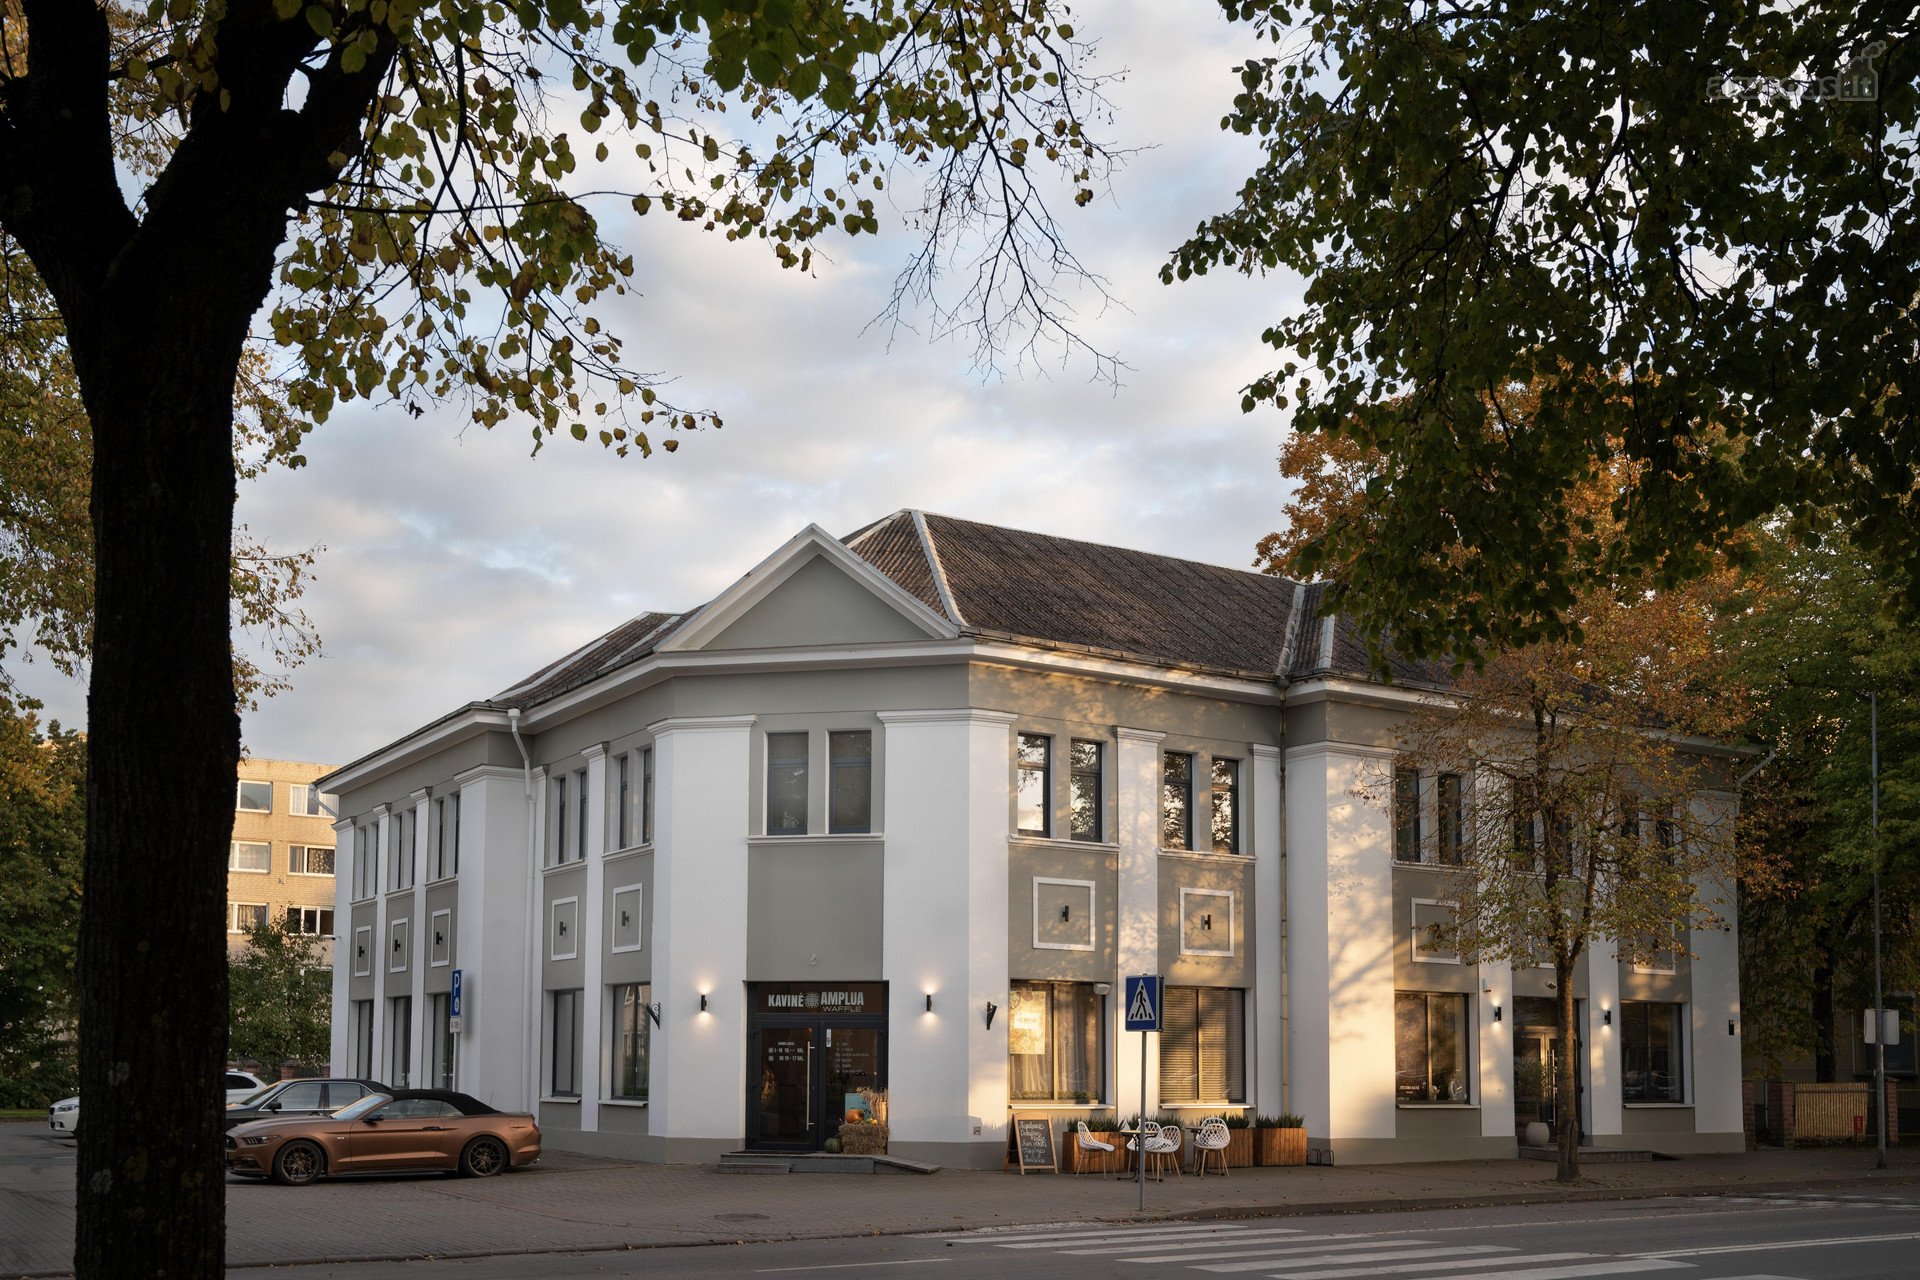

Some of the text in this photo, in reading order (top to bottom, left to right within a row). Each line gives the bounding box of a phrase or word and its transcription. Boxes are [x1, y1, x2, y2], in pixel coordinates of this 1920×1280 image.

[454, 973, 460, 996] P
[768, 991, 864, 1007] KAVINĖ AMPLUA
